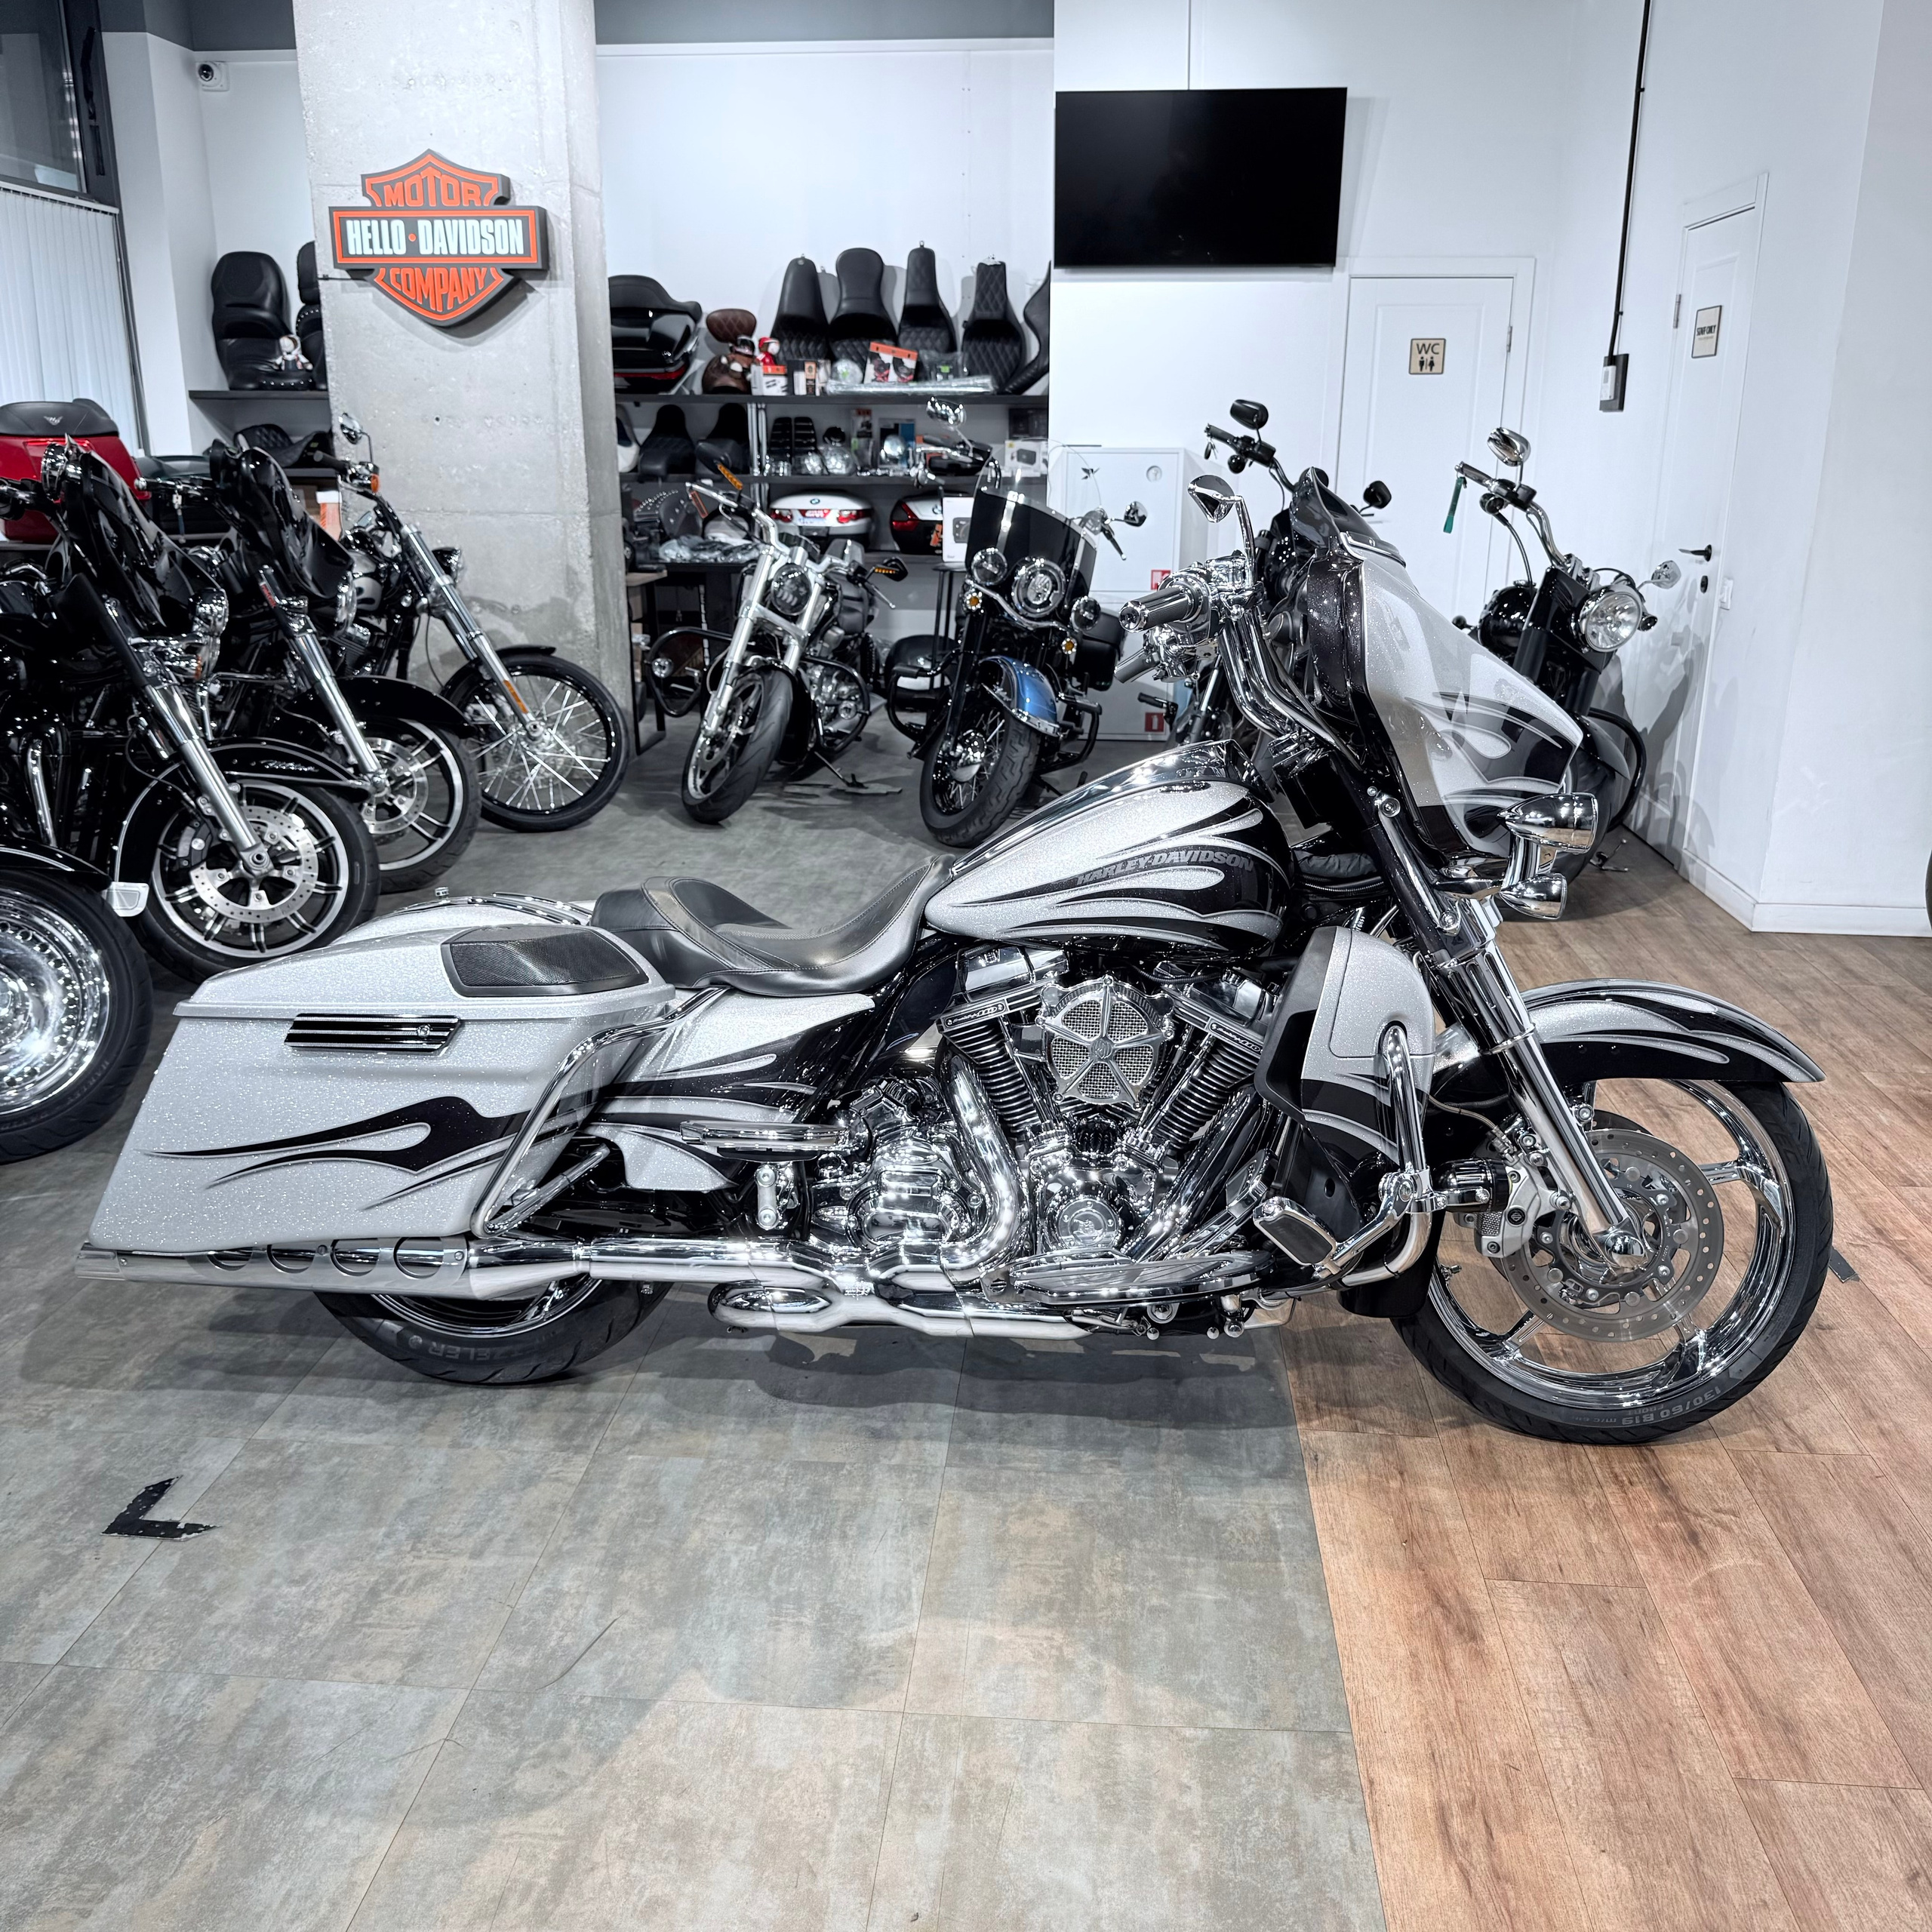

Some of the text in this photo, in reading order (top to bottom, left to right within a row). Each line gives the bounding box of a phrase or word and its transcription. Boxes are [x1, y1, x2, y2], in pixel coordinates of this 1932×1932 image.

[383, 166, 481, 207] MOTOR
[346, 219, 525, 255] HELLO DAVIDSON
[389, 267, 488, 312] COMPANY
[1416, 343, 1440, 355] WC
[1076, 850, 1254, 885] HARLEY-DAVIDSON
[1660, 1386, 1721, 1419] 130/60
